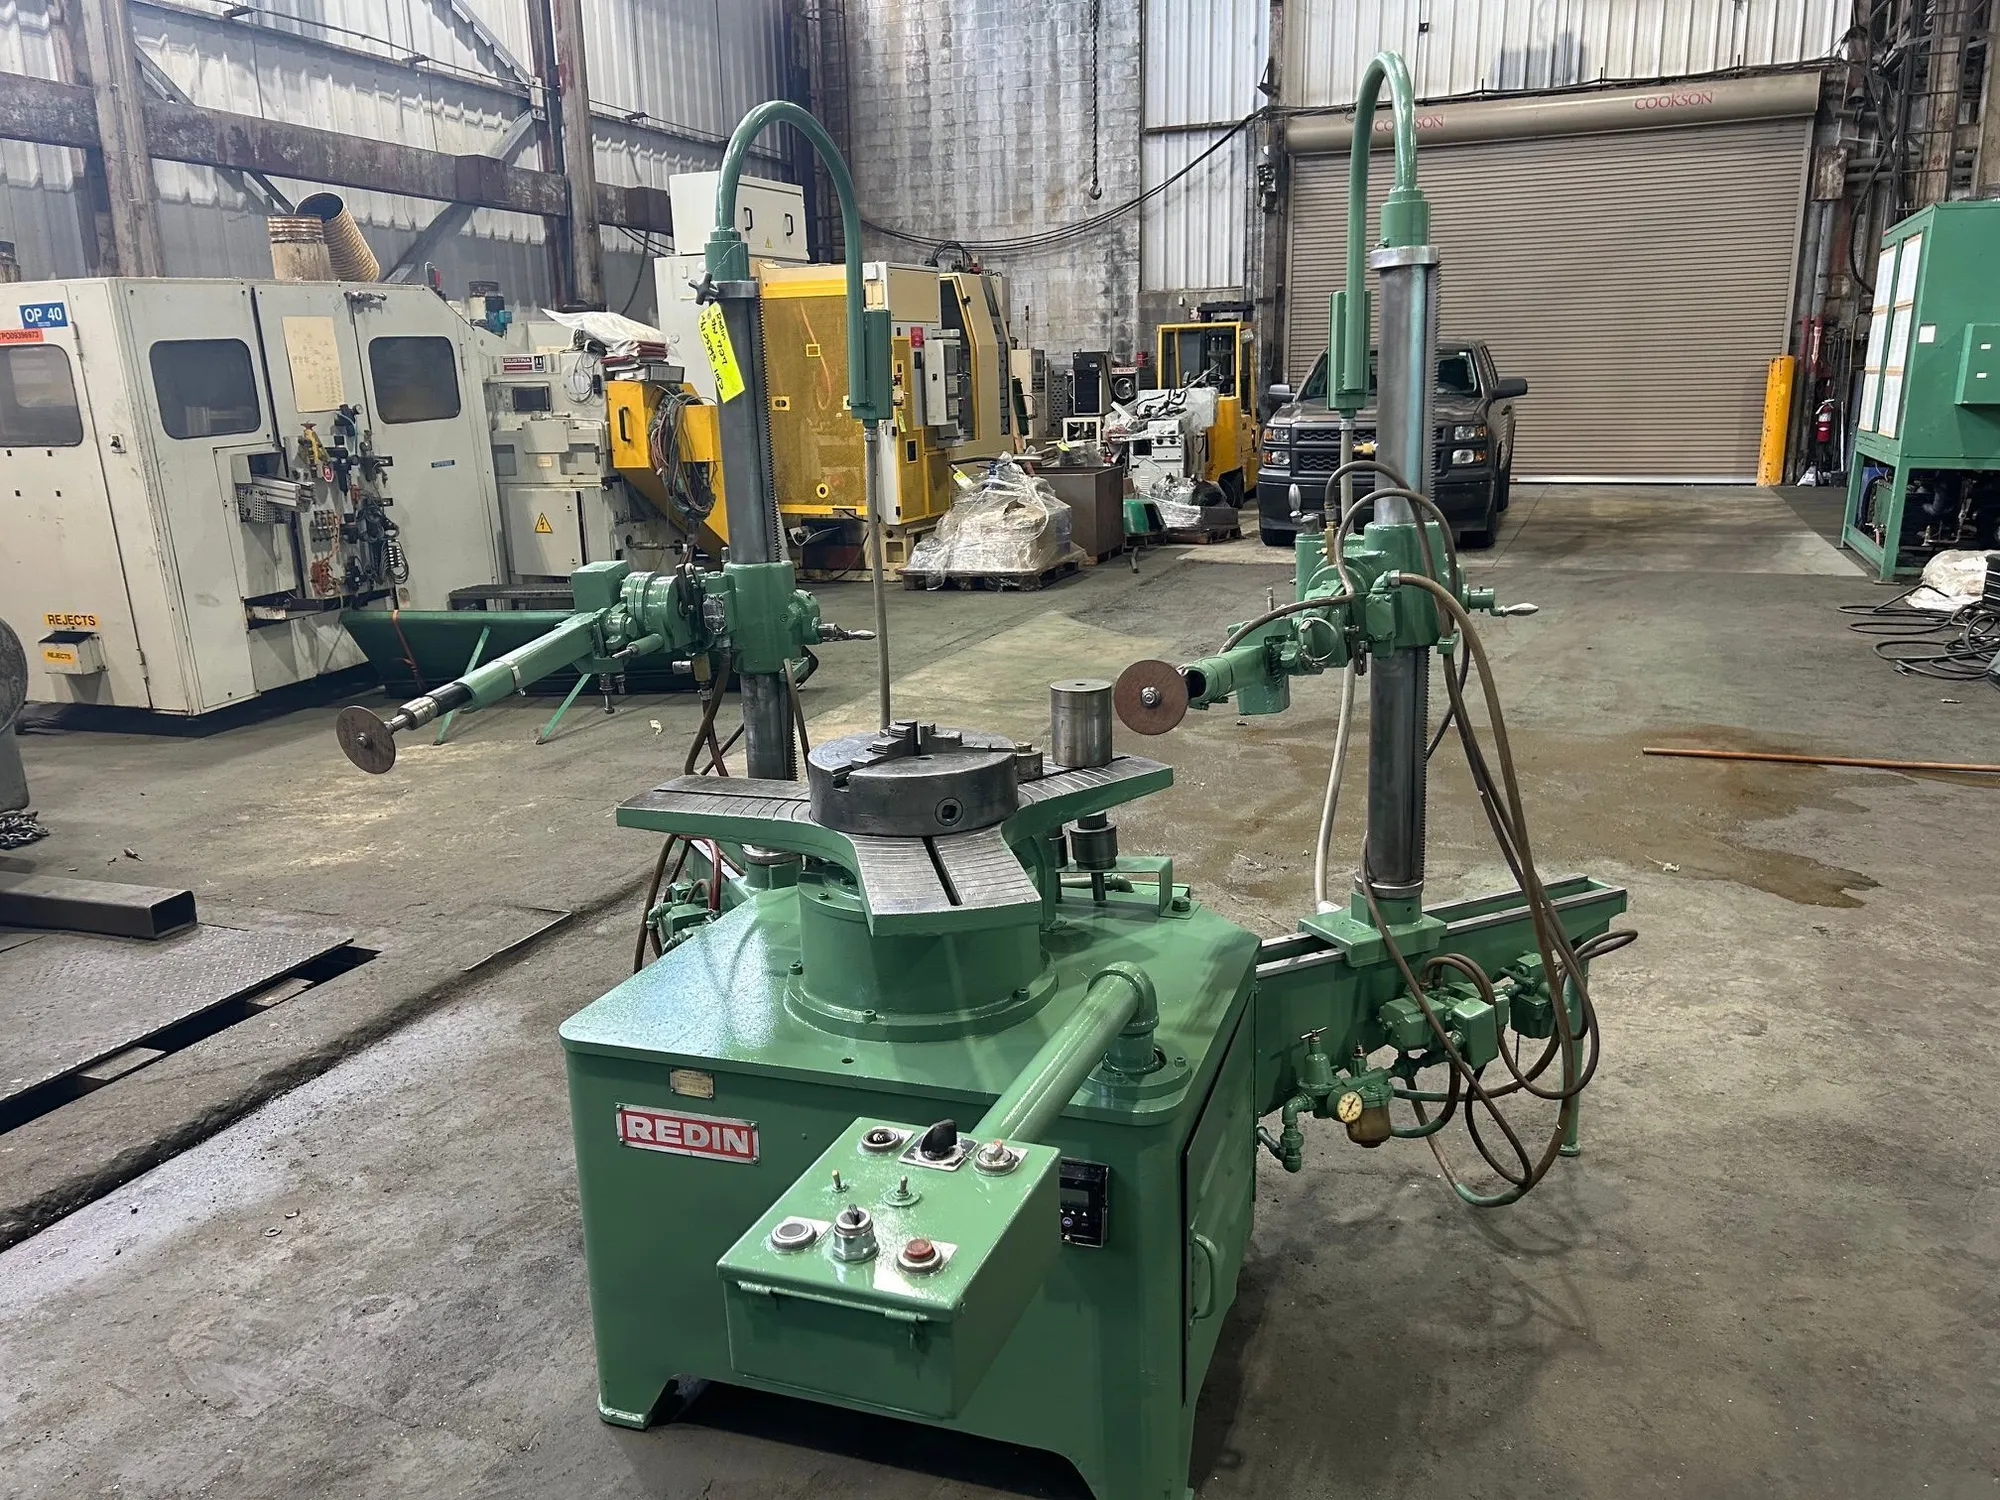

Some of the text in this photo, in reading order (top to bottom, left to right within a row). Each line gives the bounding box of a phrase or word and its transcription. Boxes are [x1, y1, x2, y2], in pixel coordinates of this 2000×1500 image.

[1635, 91, 1713, 110] COOKSON
[1375, 116, 1444, 132] COSON
[24, 307, 62, 323] OP 40
[47, 614, 96, 626] REJECTS
[625, 1114, 749, 1154] REDIN
